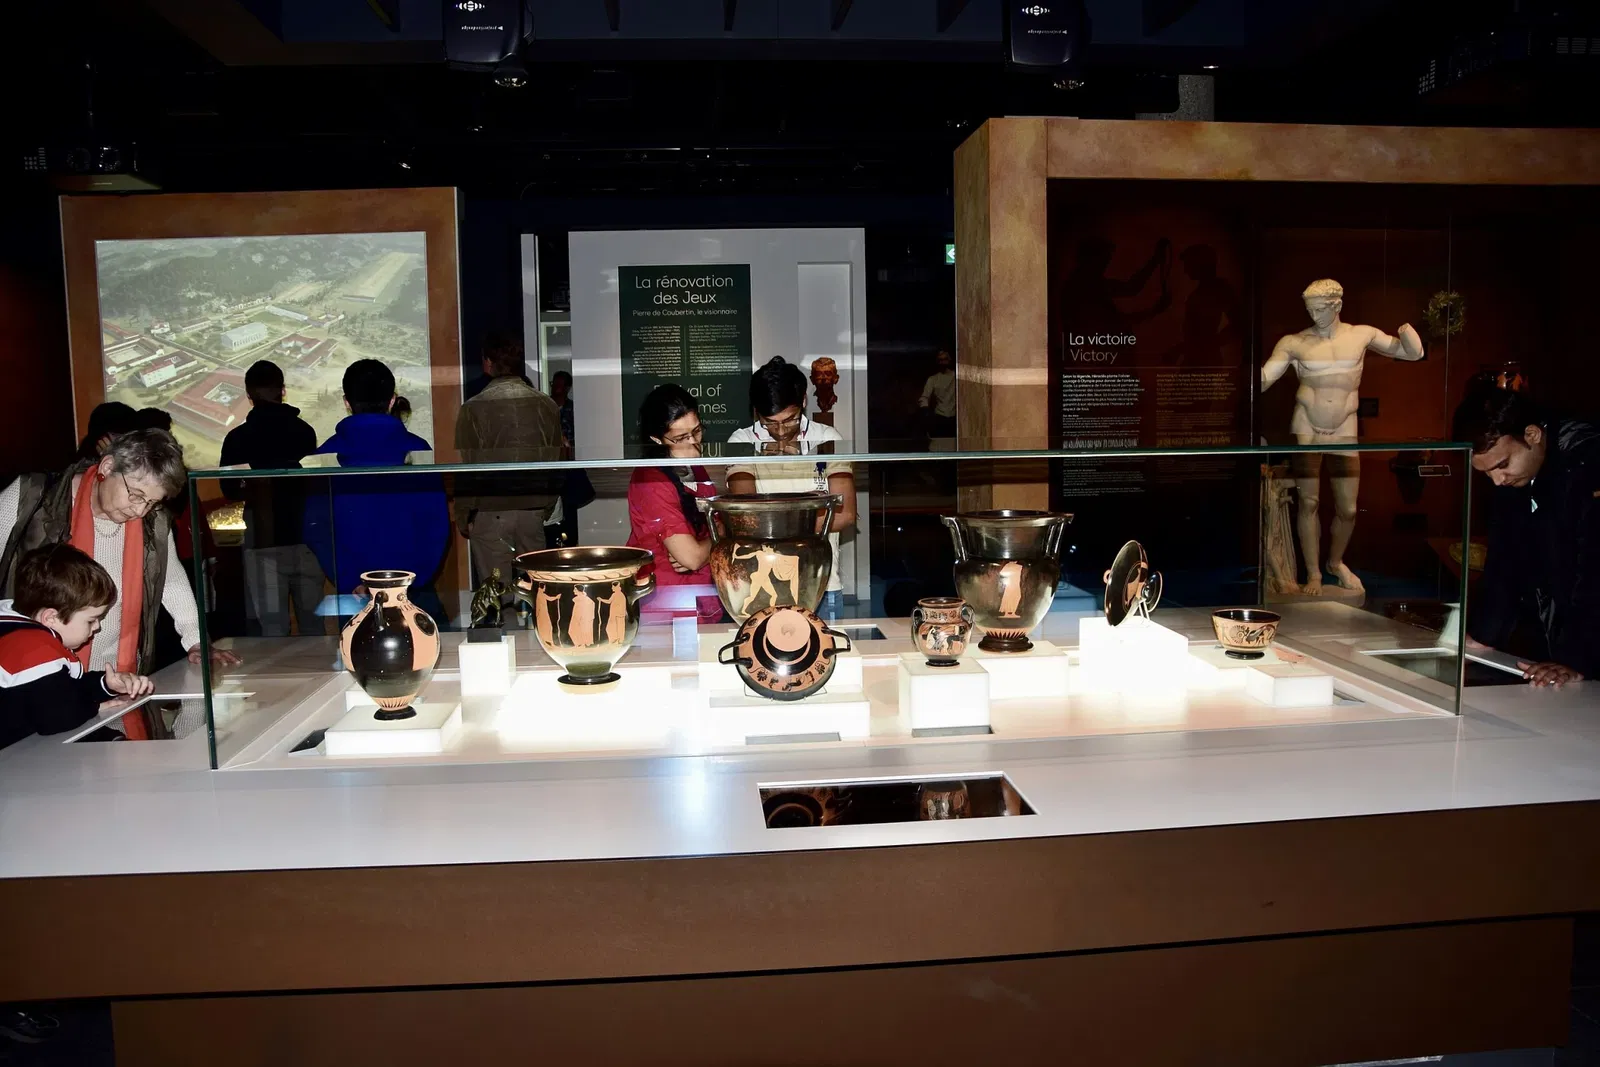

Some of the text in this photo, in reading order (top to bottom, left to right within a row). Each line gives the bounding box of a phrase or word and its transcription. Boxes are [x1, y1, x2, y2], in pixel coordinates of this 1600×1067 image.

[635, 275, 734, 289] La rénovation
[653, 291, 717, 305] des Jeux
[704, 308, 738, 316] visionnaire
[1069, 332, 1137, 346] La victoire
[1070, 349, 1118, 365] Victory
[706, 384, 722, 397] of
